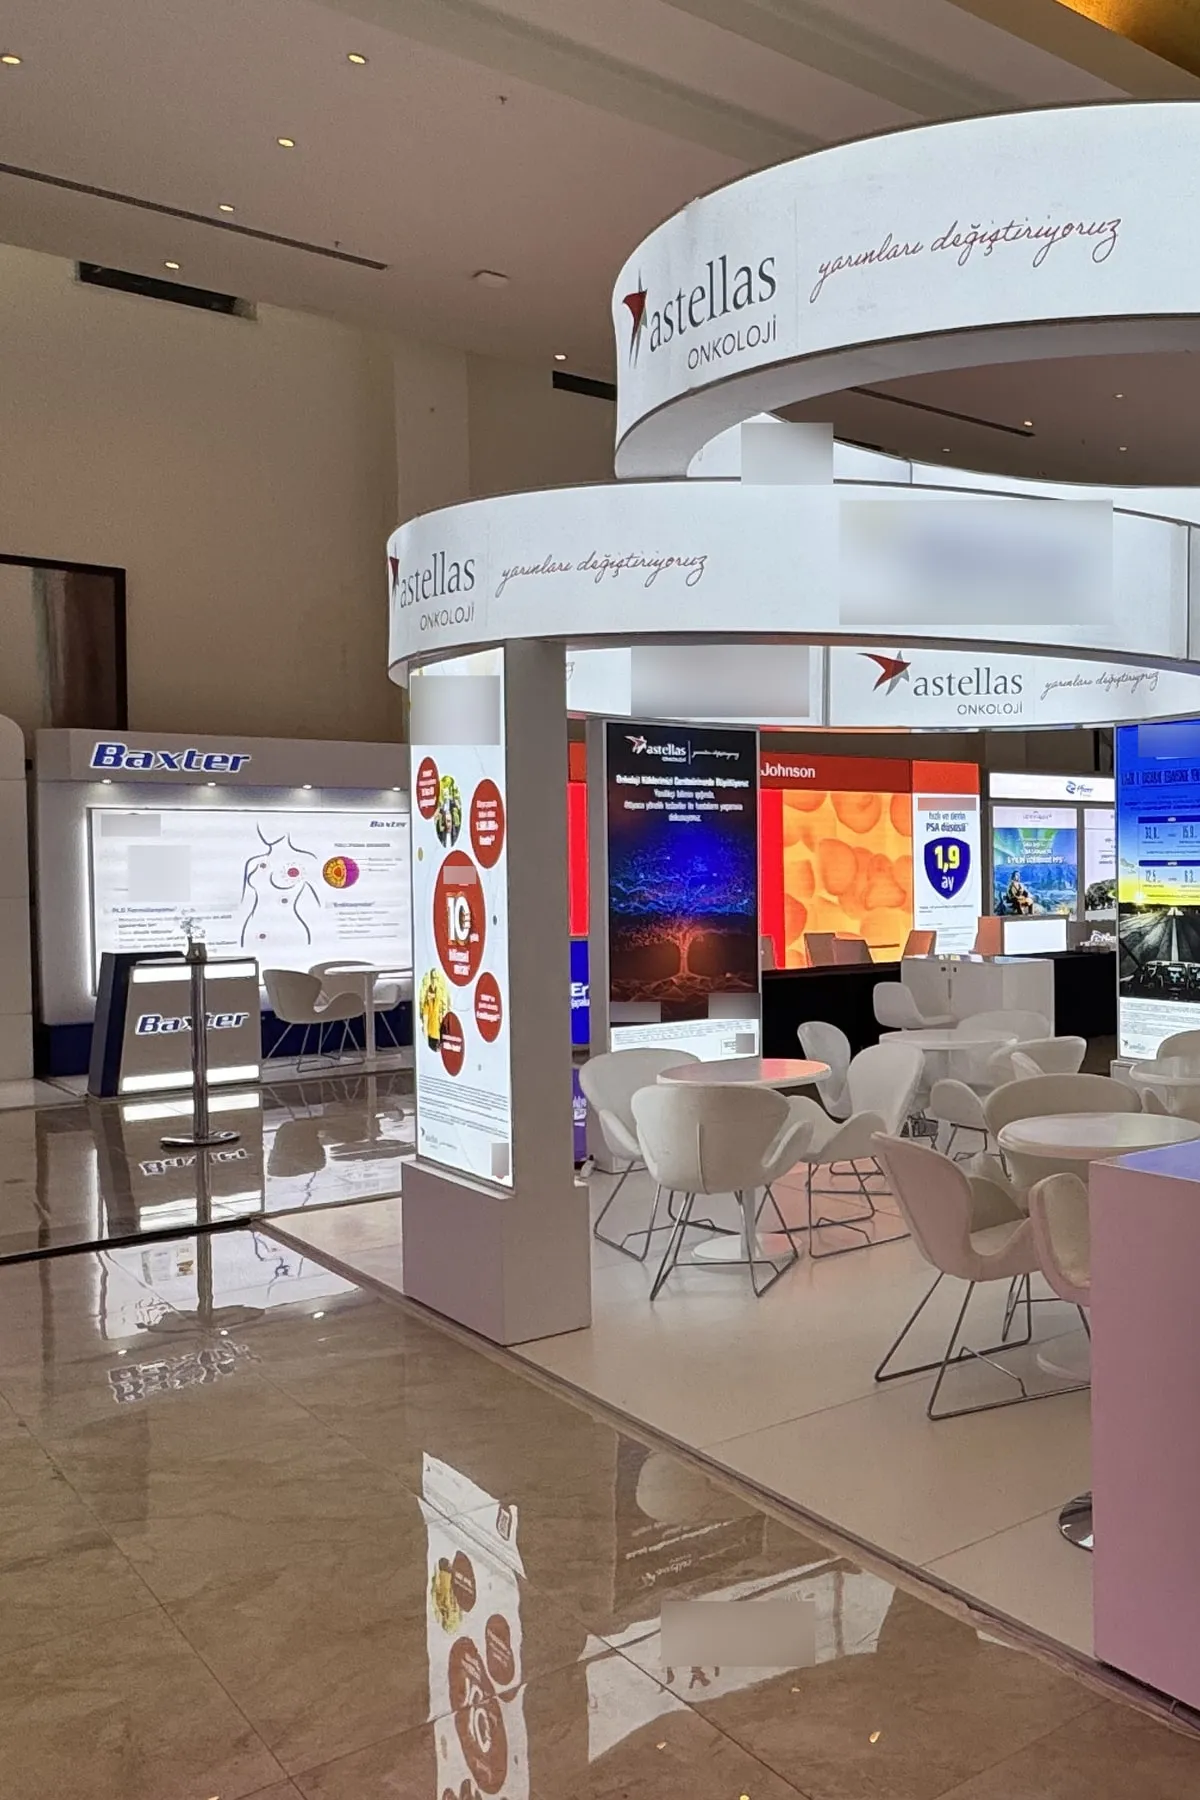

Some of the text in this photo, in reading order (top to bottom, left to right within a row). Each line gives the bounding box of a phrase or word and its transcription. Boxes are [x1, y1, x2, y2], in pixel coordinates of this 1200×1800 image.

[649, 254, 777, 353] astellas
[687, 313, 778, 371] ONKOLOJİ
[399, 550, 476, 609] astellas
[419, 605, 476, 632] ONKOLOJİ
[913, 667, 1023, 697] astellas
[957, 701, 1023, 715] ONKOLOJİ
[90, 742, 251, 774] Baxter
[761, 762, 816, 779] Johnson
[926, 822, 940, 832] PSA
[934, 844, 961, 873] 1,9
[941, 875, 955, 892] ay
